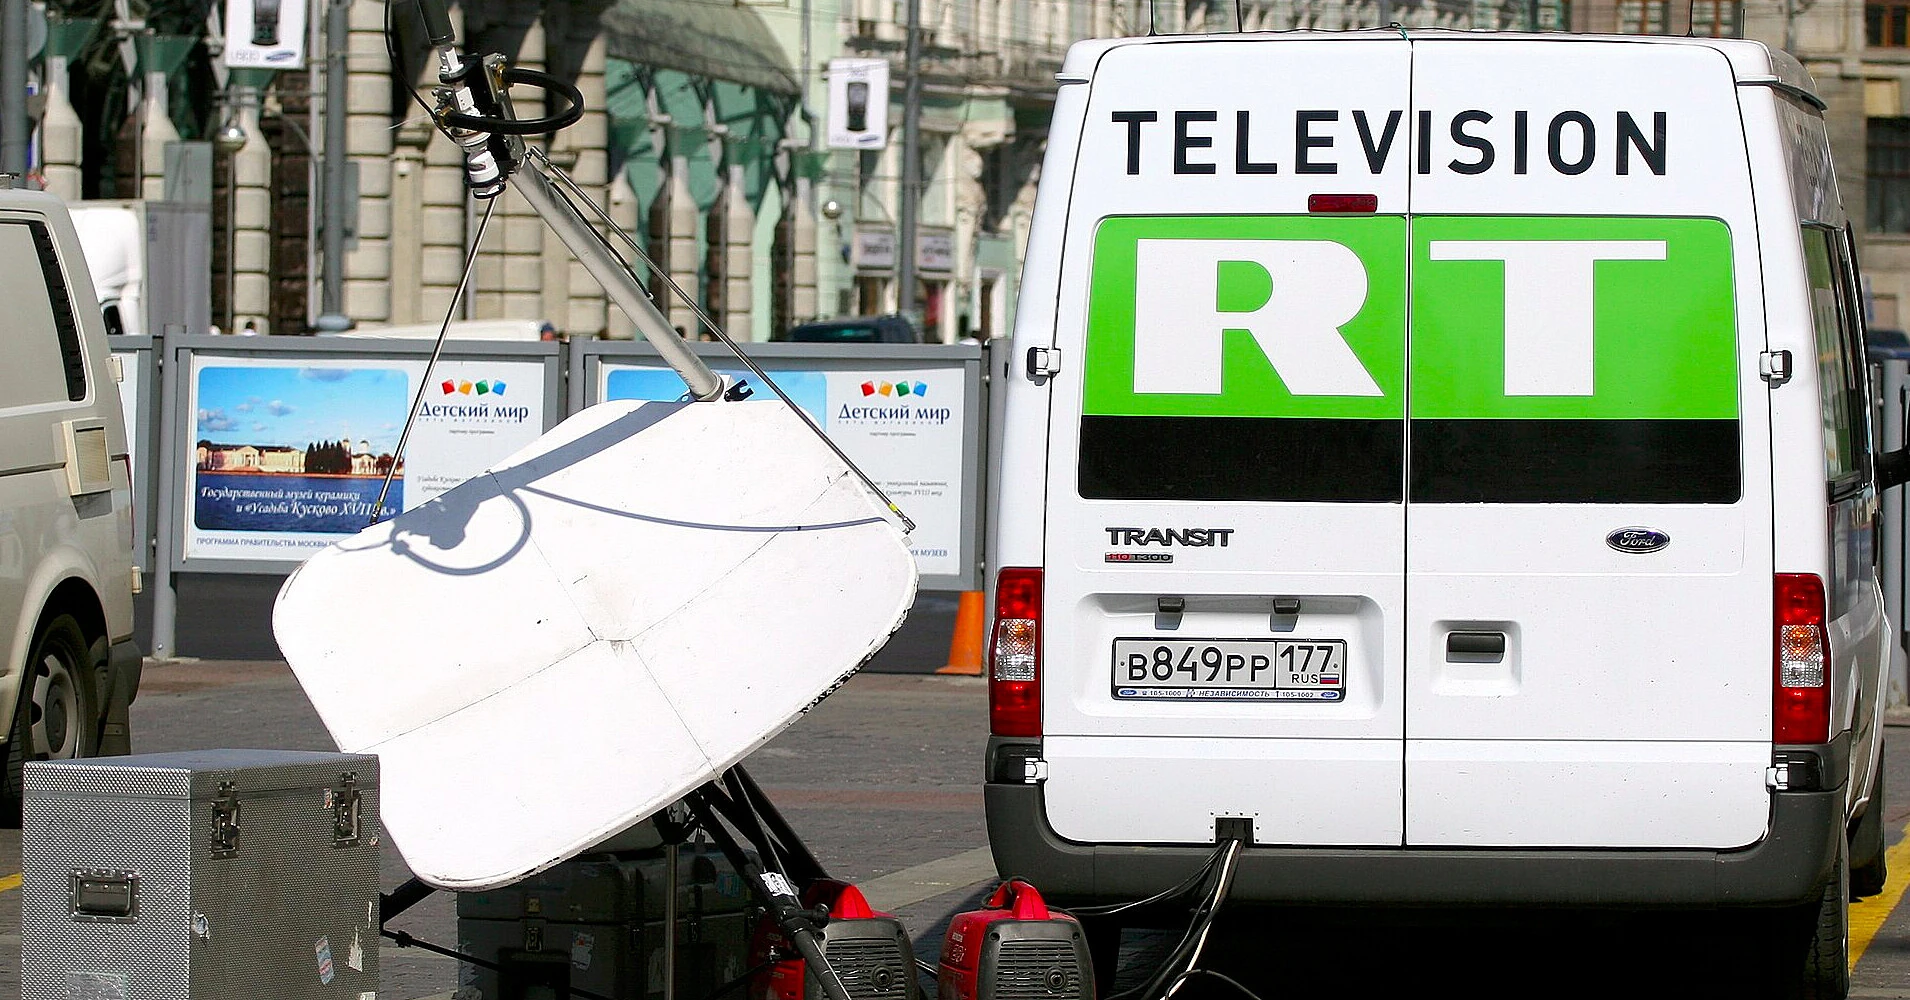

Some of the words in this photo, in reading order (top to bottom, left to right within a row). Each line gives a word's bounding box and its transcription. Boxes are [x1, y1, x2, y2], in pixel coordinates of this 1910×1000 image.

[1112, 110, 1667, 175] TELEVISION
[1133, 238, 1667, 397] RT
[419, 402, 488, 418] Детский
[494, 406, 529, 422] мир
[839, 403, 909, 419] Детский
[915, 408, 950, 424] мир
[201, 486, 284, 500] Государственный
[285, 489, 312, 500] музей
[315, 489, 360, 501] керамики
[236, 505, 243, 513] и
[291, 502, 337, 517] Кусково
[196, 537, 239, 545] ПРОГРАММА
[1105, 527, 1235, 547] TRANSIT
[1620, 531, 1655, 546] Ford
[1128, 646, 1270, 682] В849РР
[1279, 645, 1334, 673] 177
[1291, 674, 1318, 684] RUS
[1198, 690, 1270, 698] НЕЗАВИСИМОСТЬ
